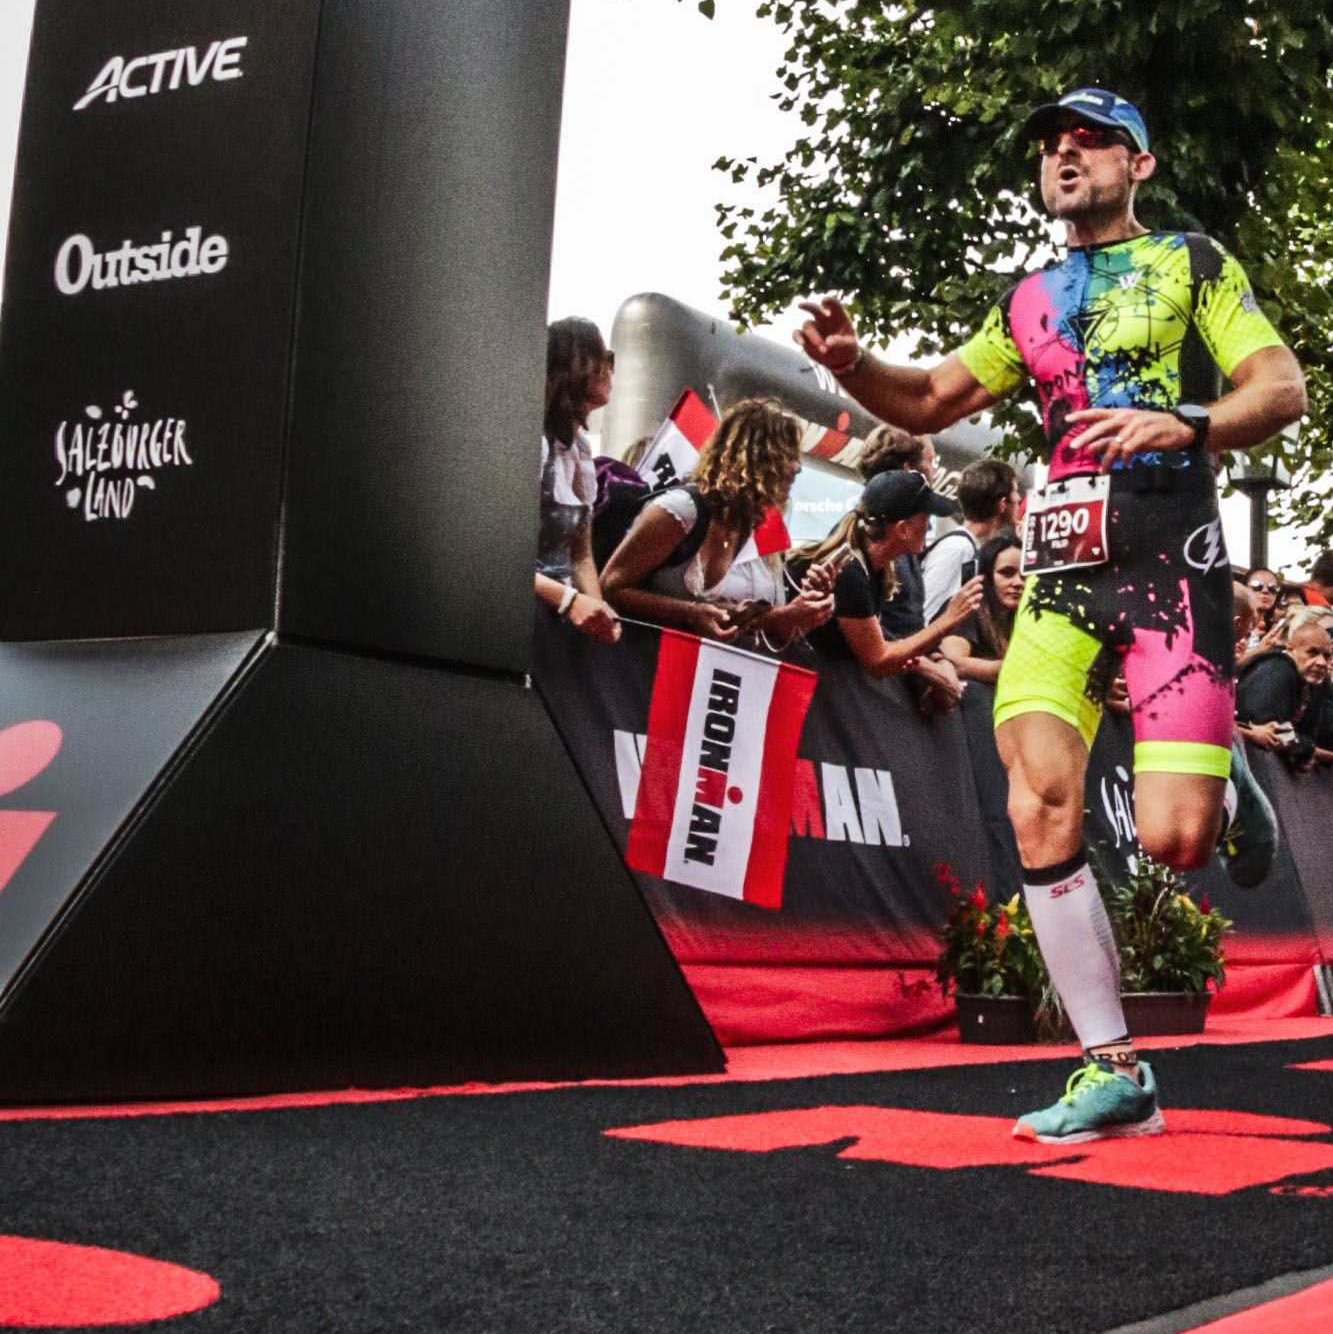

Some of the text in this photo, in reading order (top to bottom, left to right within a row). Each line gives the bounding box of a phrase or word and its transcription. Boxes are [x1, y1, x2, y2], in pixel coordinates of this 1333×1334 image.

[72, 36, 247, 110] ACTIVE
[55, 226, 229, 295] Outside
[55, 418, 193, 485] SALZBURGER
[85, 471, 135, 522] LAND
[1041, 508, 1090, 542] 1290
[684, 668, 743, 866] IRONMAN
